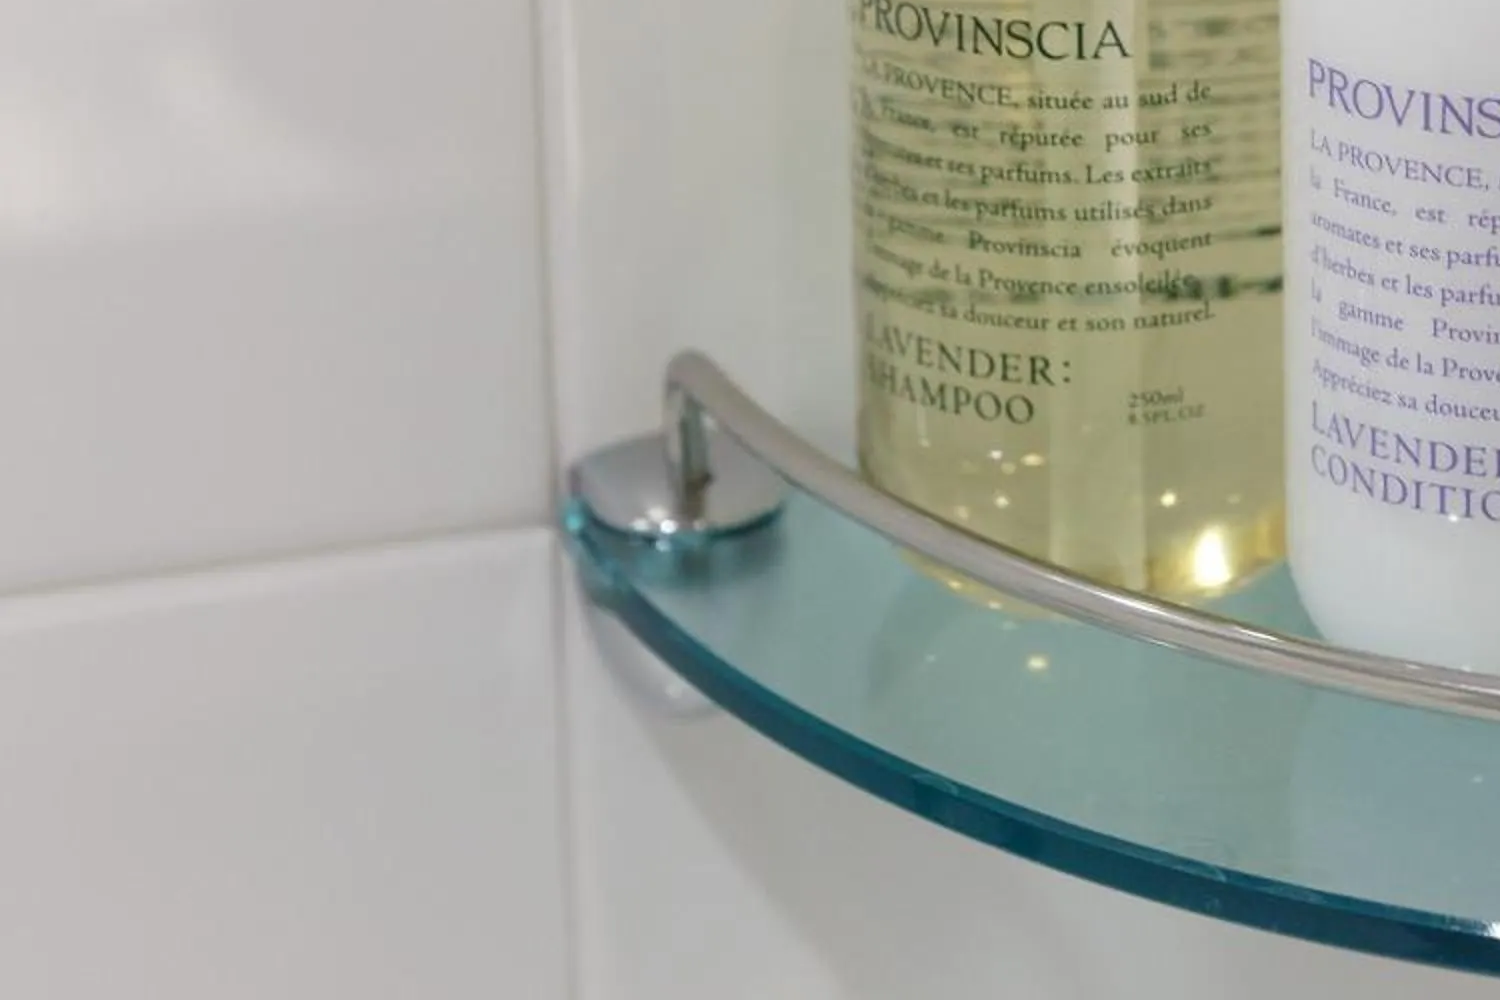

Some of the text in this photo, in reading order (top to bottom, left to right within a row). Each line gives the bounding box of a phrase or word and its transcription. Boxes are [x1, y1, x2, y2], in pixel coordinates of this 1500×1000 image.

[1027, 88, 1093, 109] située
[1104, 91, 1129, 108] au
[1139, 83, 1177, 107] sud
[1187, 80, 1211, 102] de
[1000, 126, 1083, 152] réputée
[1106, 129, 1159, 152] pour
[1182, 125, 1211, 139] ses
[980, 160, 1078, 184] parfums.
[1086, 166, 1124, 183] Les
[1132, 158, 1211, 182] extraits
[1310, 128, 1332, 157] LA
[1337, 145, 1489, 192] PROVENCE,
[976, 194, 1066, 225] parfums
[1074, 196, 1157, 222] utilisés
[1162, 194, 1213, 216] dans
[1333, 177, 1397, 215] France,
[1415, 205, 1446, 223] est
[968, 229, 1212, 260] Provinscia évoquent
[1385, 240, 1402, 254] et
[1409, 243, 1441, 261] ses
[955, 263, 971, 286] la
[978, 269, 1077, 295] Provence
[1381, 276, 1399, 291] et
[1406, 275, 1433, 298] les
[963, 302, 1050, 331] douceur
[1057, 315, 1079, 331] et
[1085, 314, 1125, 331] son
[1133, 301, 1216, 329] naturel.
[1338, 300, 1404, 331] gamme
[1386, 348, 1409, 370] de
[1416, 352, 1434, 376] la
[867, 354, 1035, 424] SHAMPOO
[1312, 359, 1392, 406] Appréciez
[1397, 393, 1417, 410] sa
